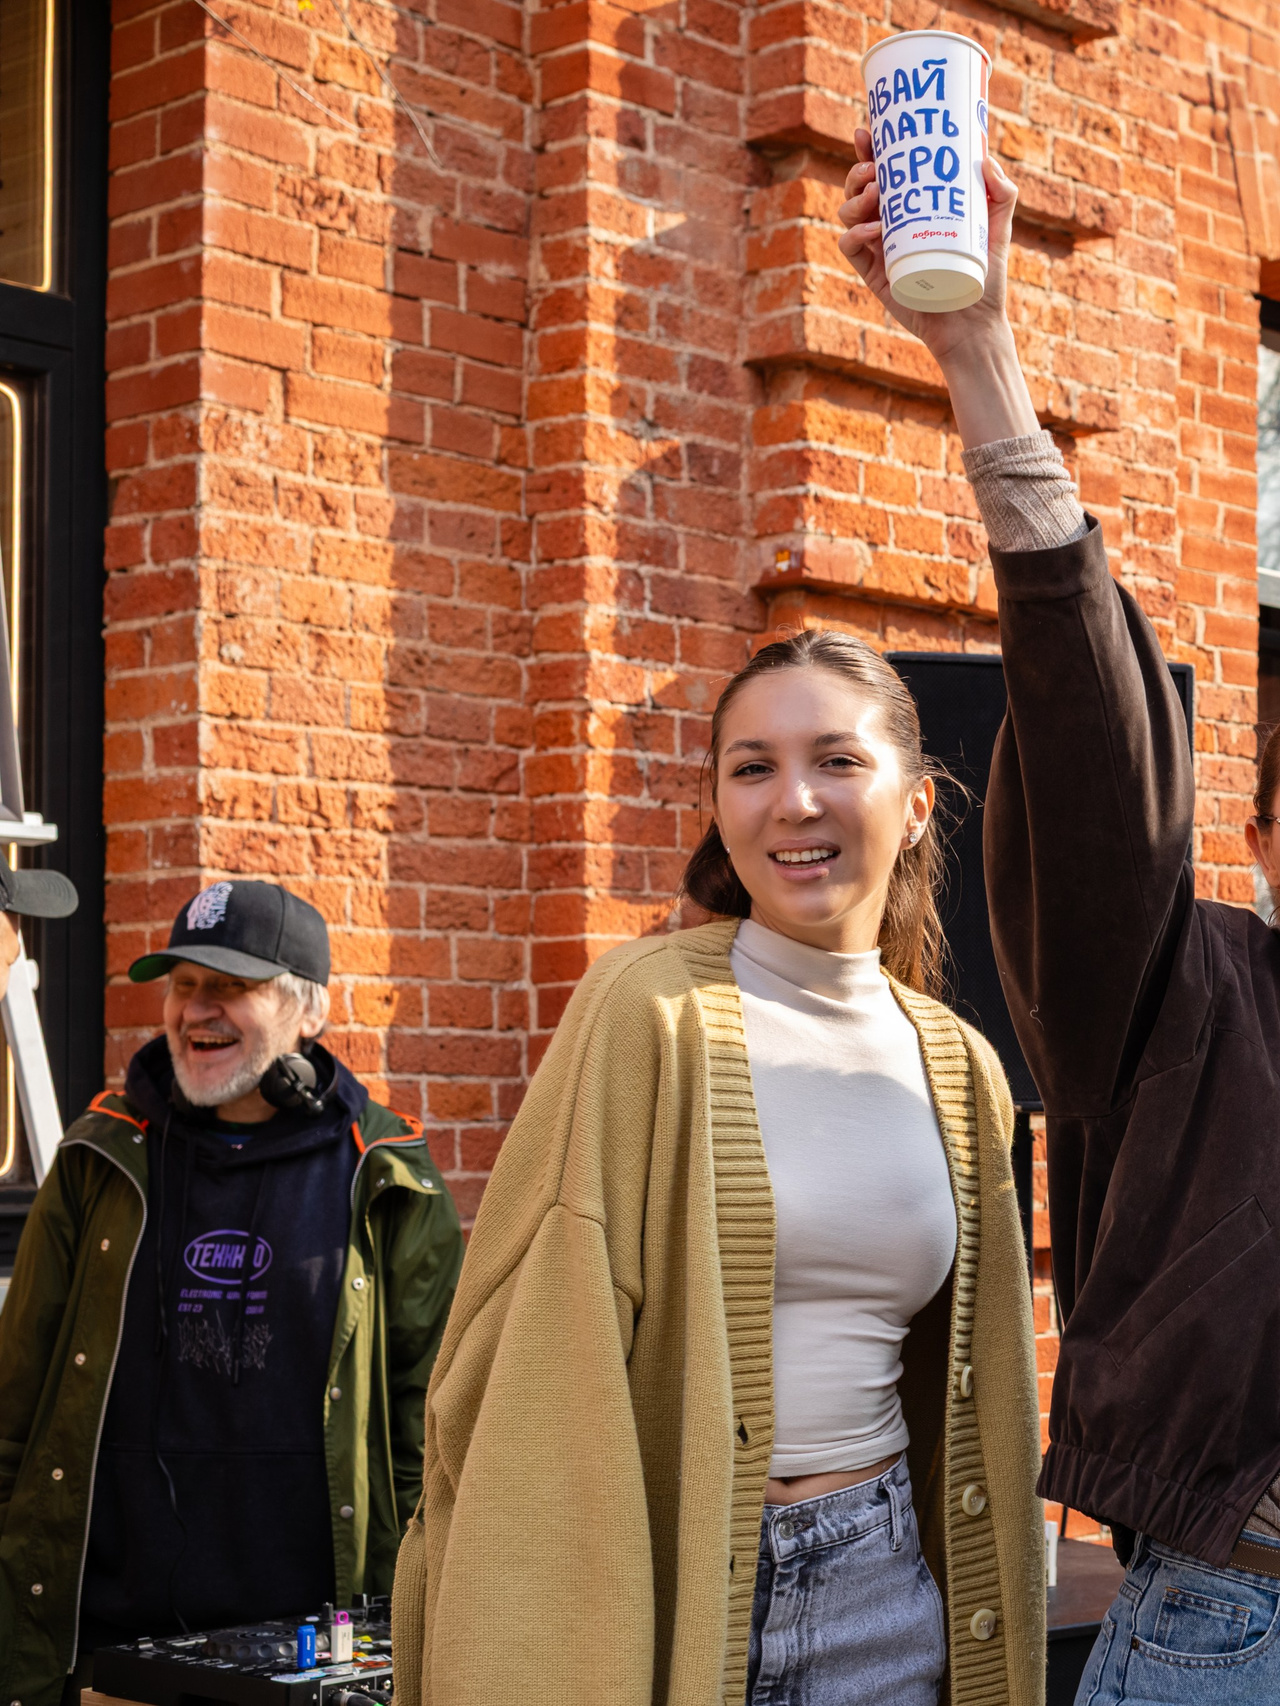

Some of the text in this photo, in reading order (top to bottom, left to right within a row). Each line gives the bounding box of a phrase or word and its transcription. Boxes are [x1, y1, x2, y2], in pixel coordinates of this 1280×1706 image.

[869, 58, 947, 125] АВАЙ
[873, 108, 959, 158] ЕЛАТЬ
[878, 146, 960, 195] ОБРО
[881, 185, 965, 229] МЕСТЕ
[912, 229, 958, 240] добро.рф
